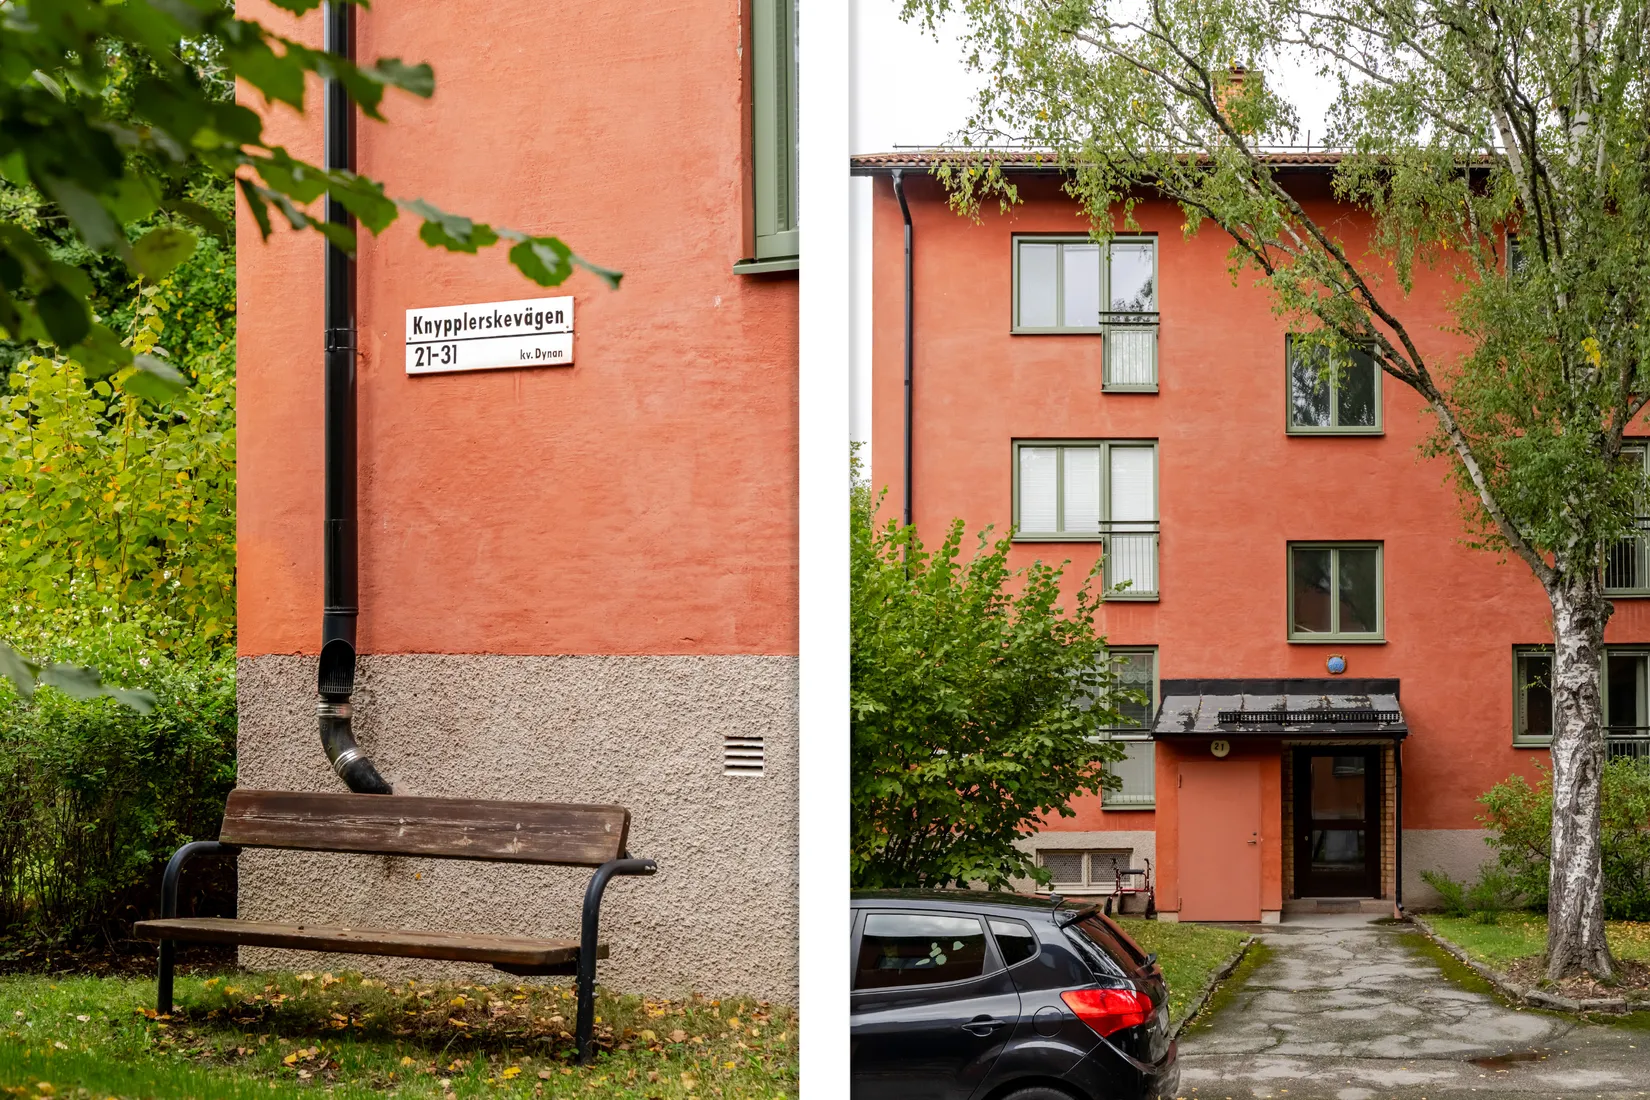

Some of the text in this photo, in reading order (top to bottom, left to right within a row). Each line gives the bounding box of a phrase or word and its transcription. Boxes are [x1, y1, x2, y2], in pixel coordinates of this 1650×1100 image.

[413, 307, 564, 338] Knypplerskevägen
[415, 344, 457, 367] 21-31
[1214, 742, 1224, 751] 21
